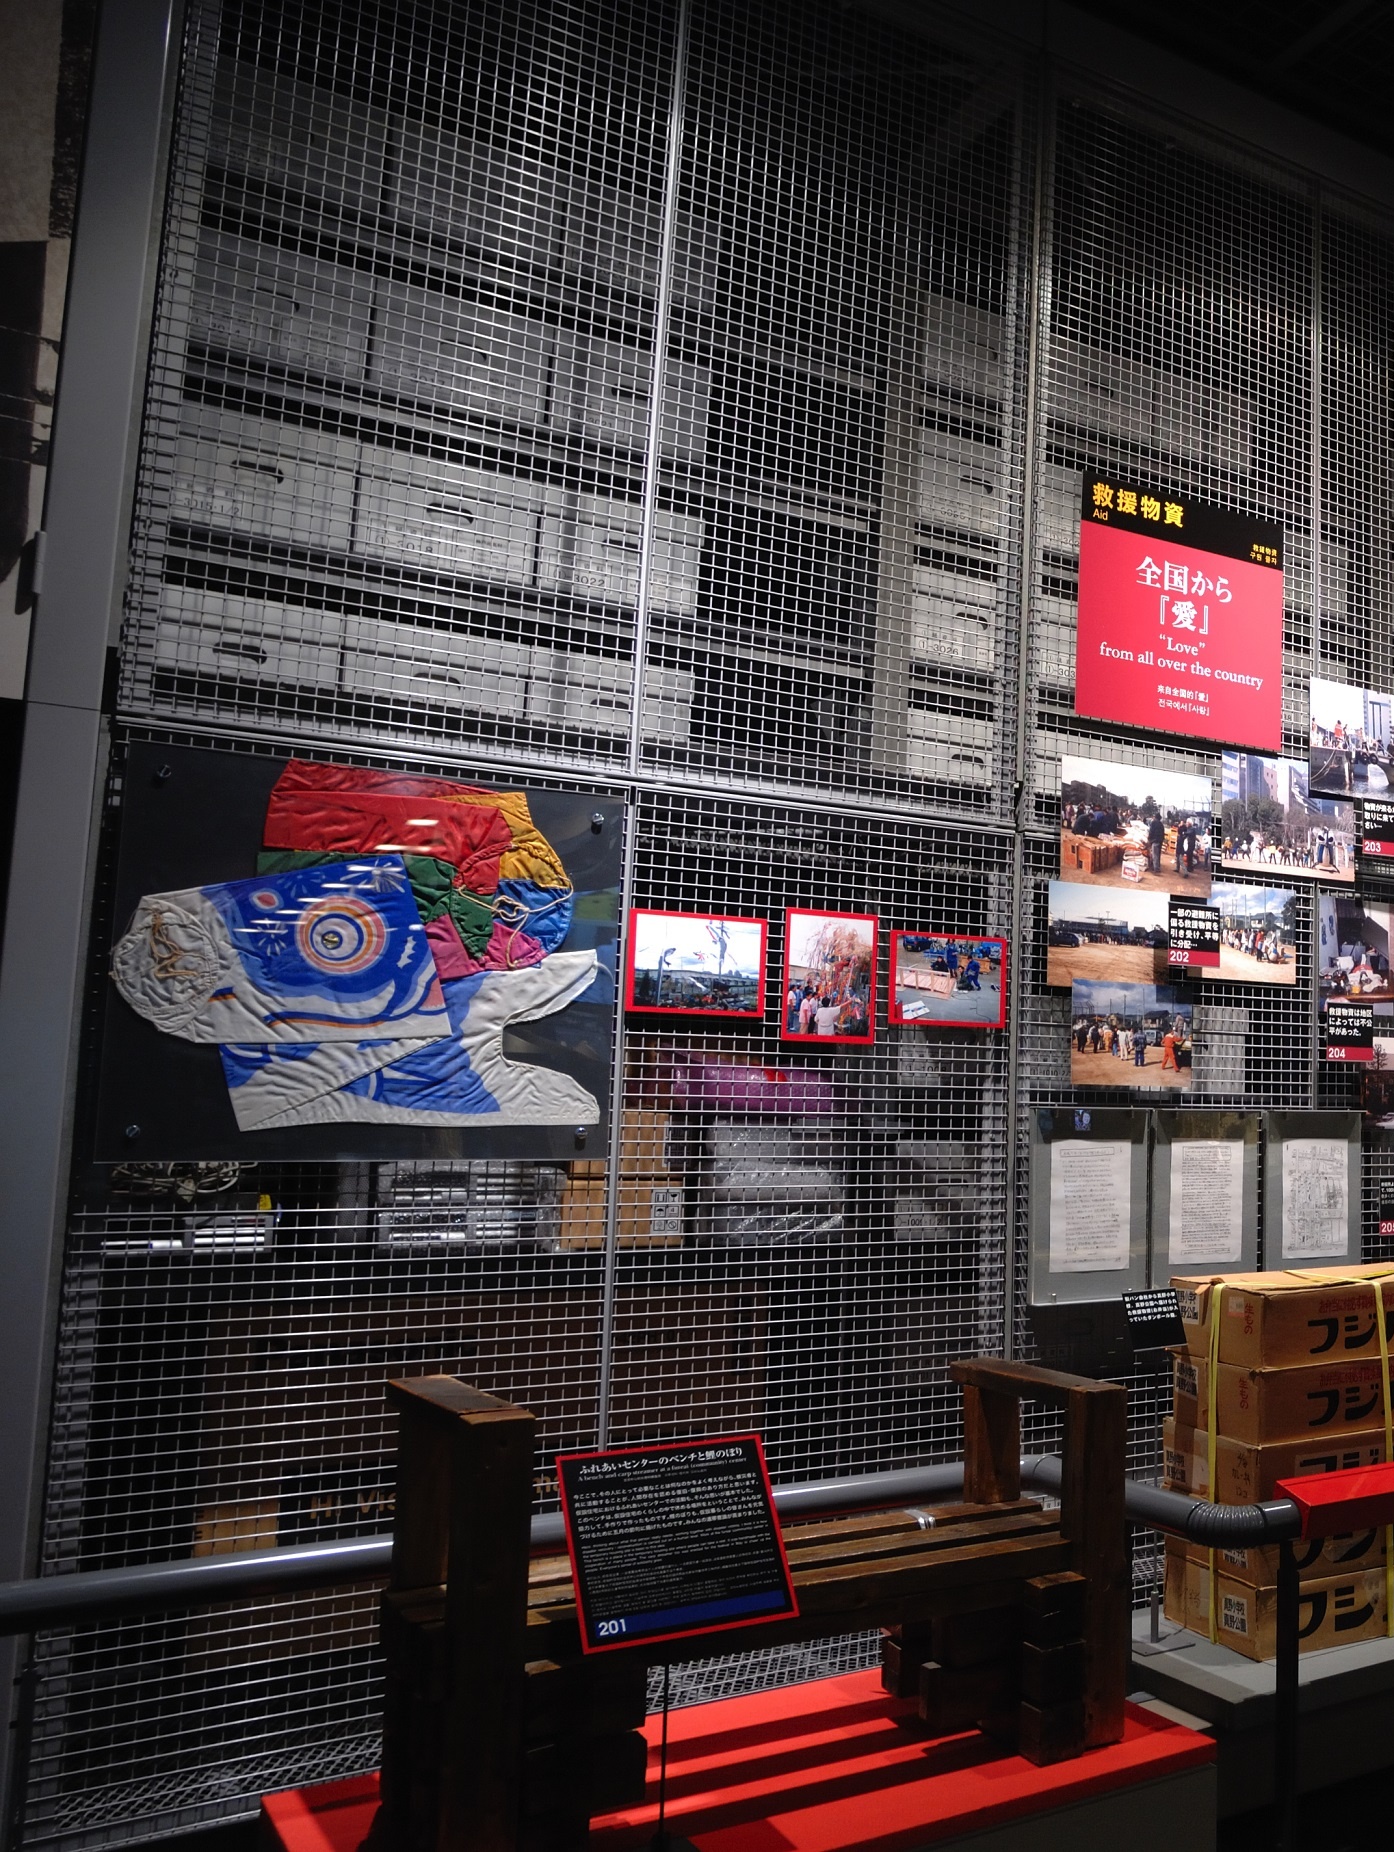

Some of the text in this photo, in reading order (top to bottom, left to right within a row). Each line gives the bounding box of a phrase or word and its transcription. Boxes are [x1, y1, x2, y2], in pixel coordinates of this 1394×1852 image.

[1092, 482, 1184, 528] 救援物資
[1092, 508, 1109, 522] Aid
[1135, 555, 1233, 603] 全国から
[1159, 594, 1210, 635] 『愛』
[1099, 641, 1264, 690] from all over the country
[1364, 841, 1381, 853] 203
[1170, 908, 1219, 920] 一部の避難所に
[1170, 950, 1189, 963] 202
[1329, 1007, 1373, 1018] 救援物資は地区
[1329, 1017, 1373, 1027] によっては不公
[1328, 1047, 1346, 1059] 204
[579, 1447, 743, 1475] ふれあいセンターのベンチと鯉のぼり
[598, 1618, 627, 1636] 201
